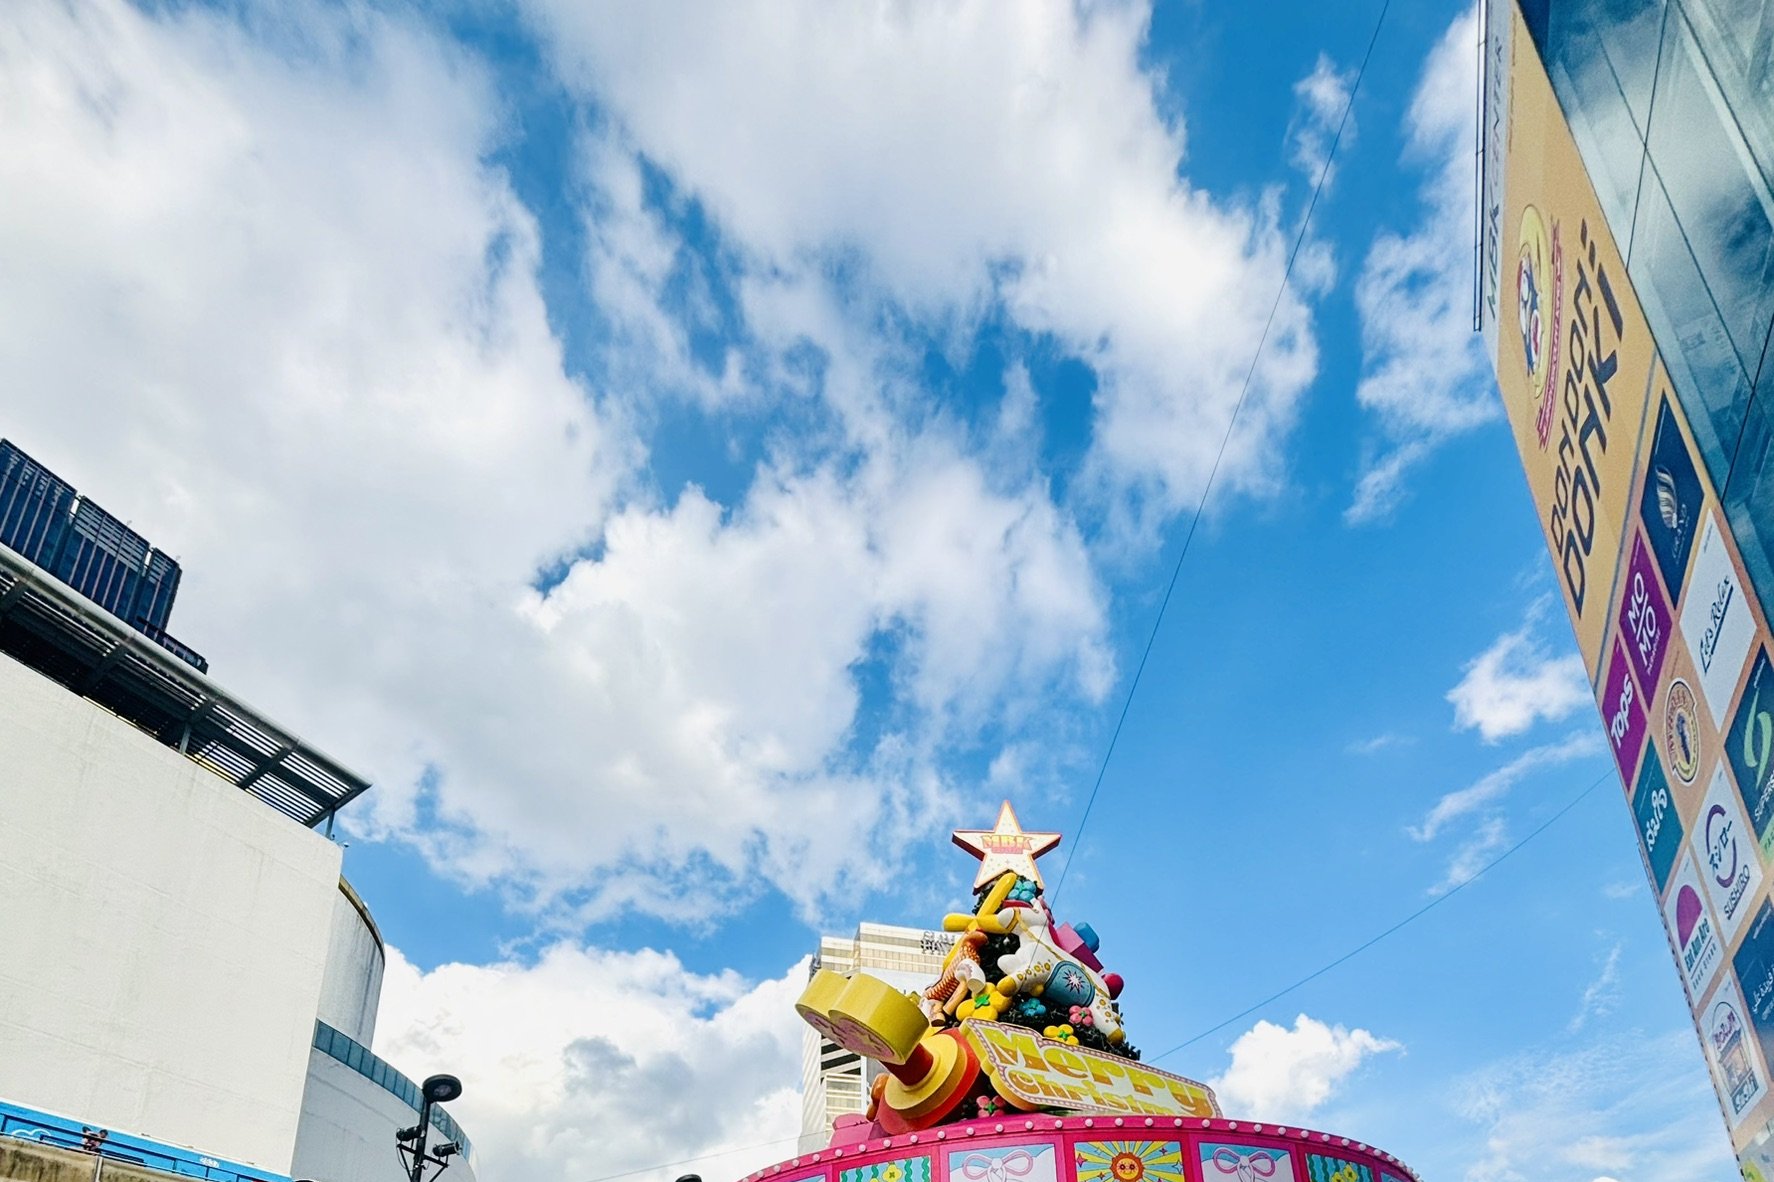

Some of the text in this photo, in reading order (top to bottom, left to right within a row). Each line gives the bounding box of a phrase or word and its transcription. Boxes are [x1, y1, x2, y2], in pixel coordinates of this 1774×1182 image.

[1551, 258, 1592, 558] DON DON
[1628, 572, 1644, 634] MO
[1639, 606, 1656, 667] MO
[1611, 673, 1633, 749] Tops
[1724, 864, 1750, 917] SUSHIRO
[978, 1027, 1214, 1118] Merry
